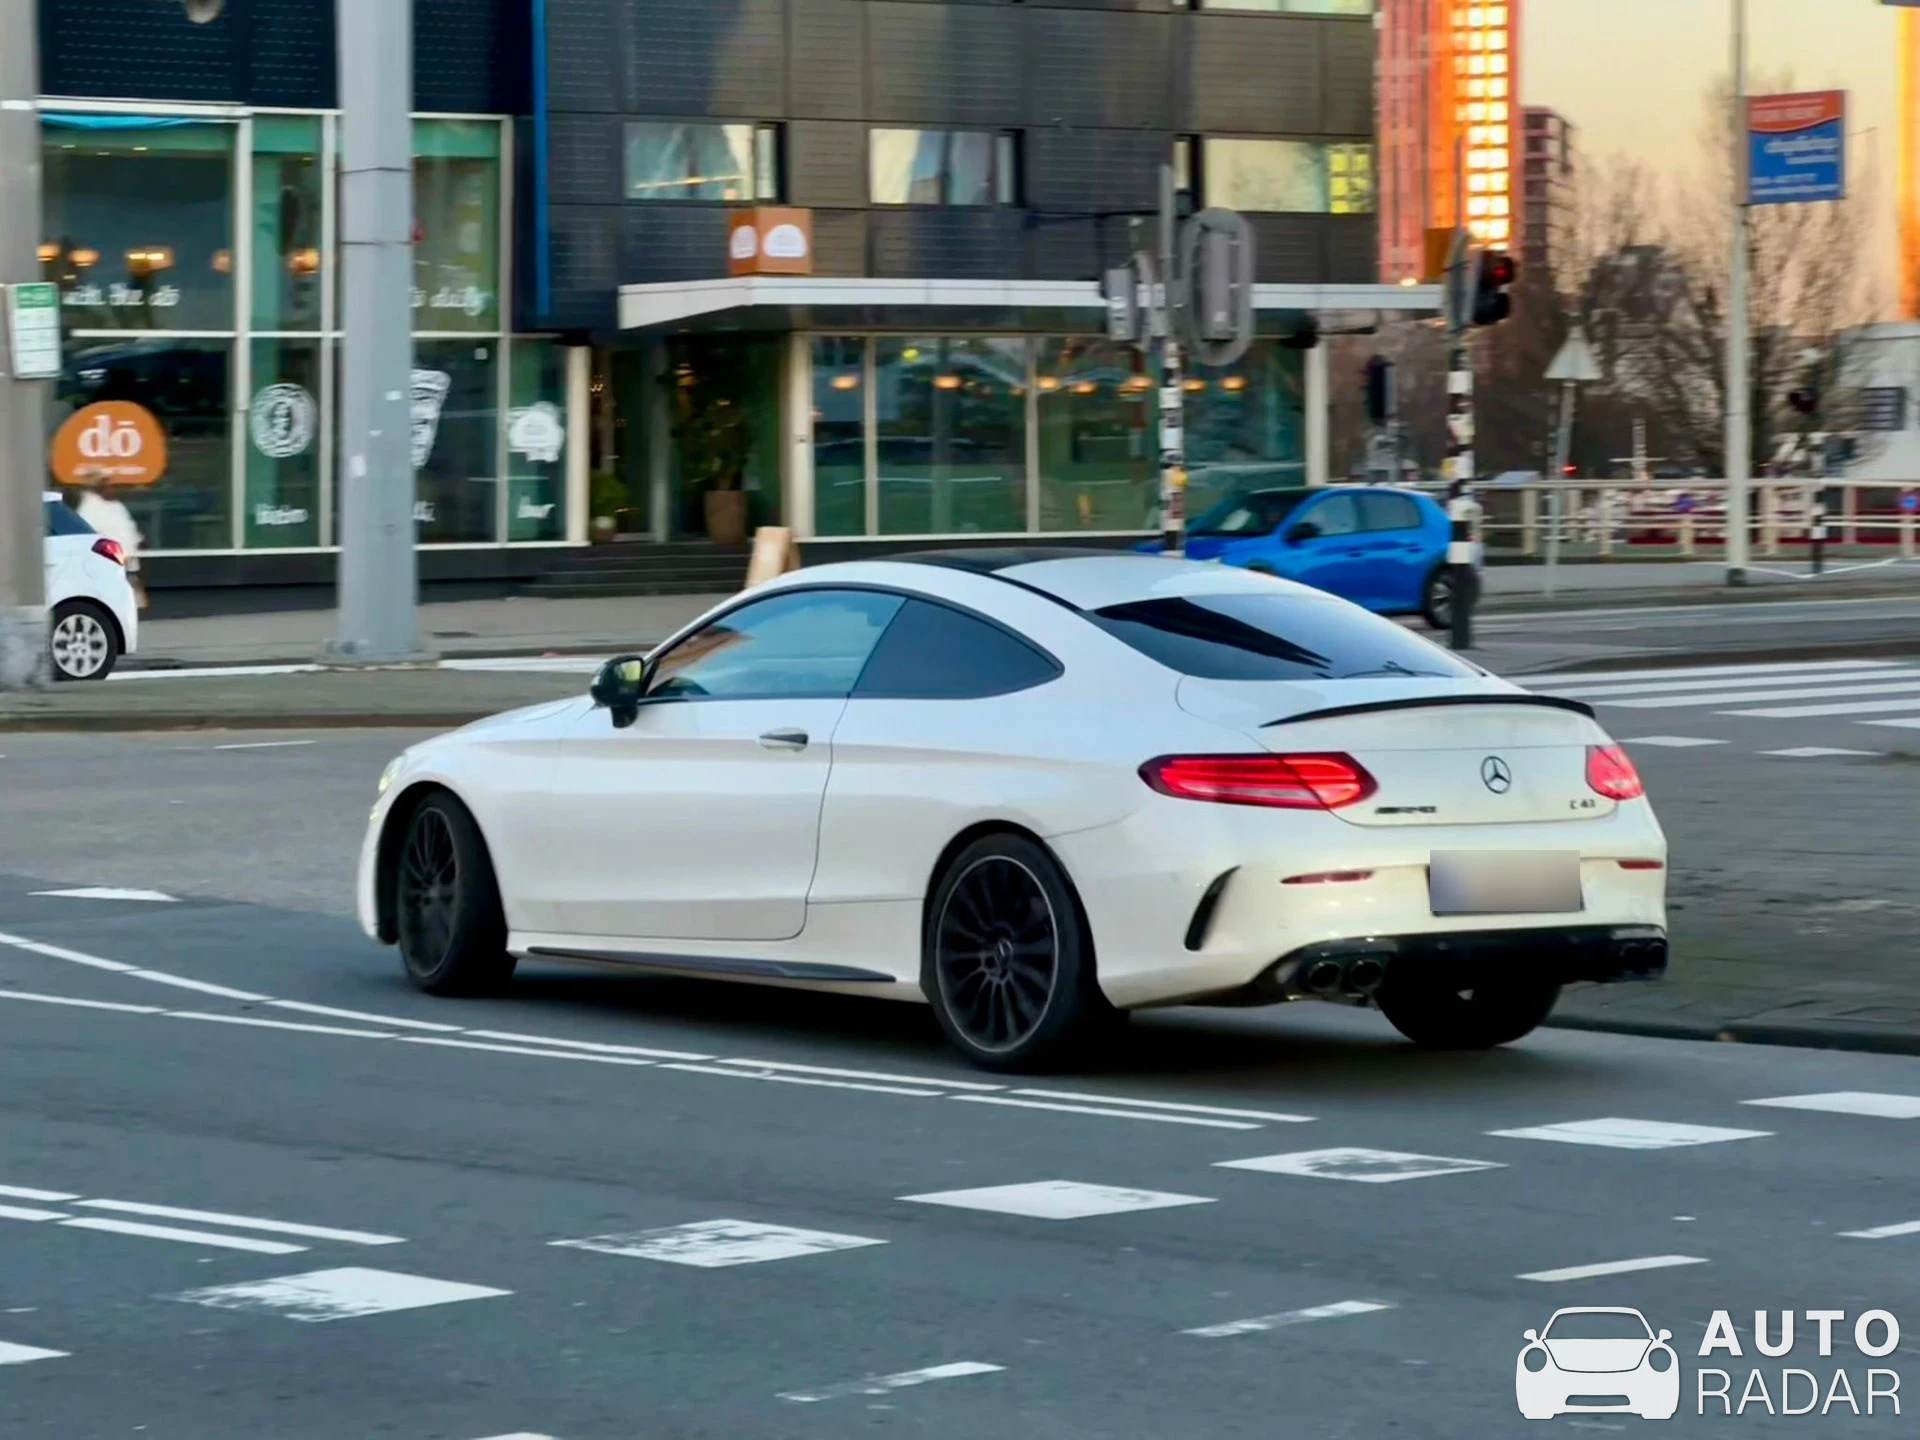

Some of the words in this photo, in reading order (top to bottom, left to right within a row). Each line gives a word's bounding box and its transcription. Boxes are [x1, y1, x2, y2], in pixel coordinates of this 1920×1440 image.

[77, 413, 142, 457] dō
[1569, 799, 1578, 810] C
[1580, 798, 1596, 809] 43
